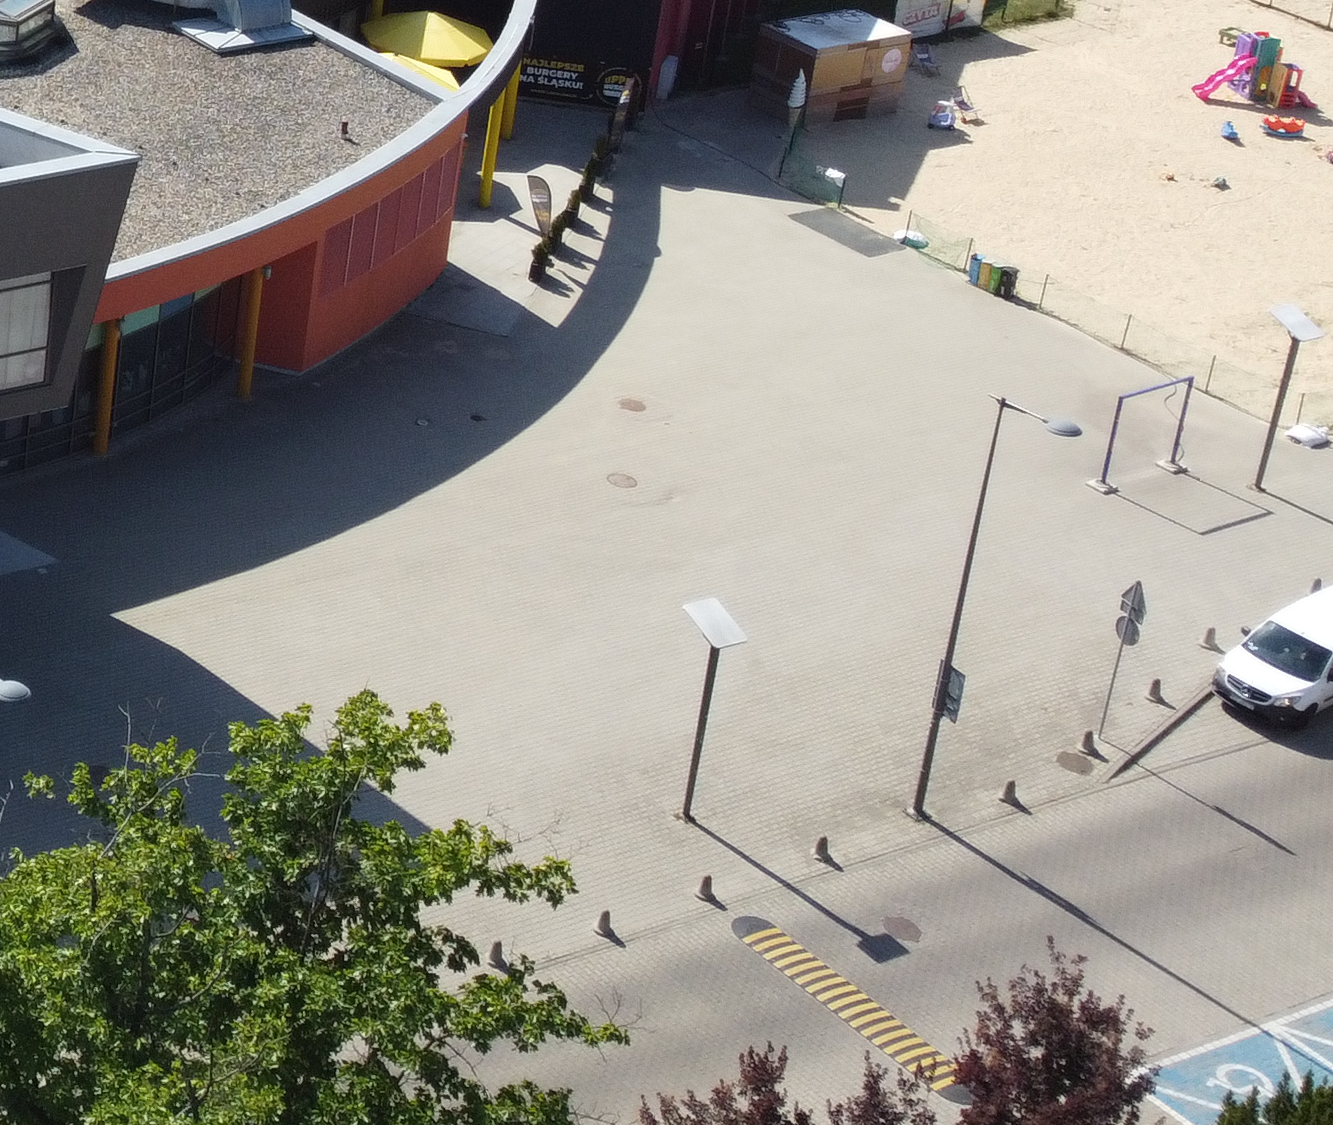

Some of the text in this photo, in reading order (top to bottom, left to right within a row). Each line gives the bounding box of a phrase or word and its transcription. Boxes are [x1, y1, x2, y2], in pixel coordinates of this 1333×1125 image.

[523, 57, 585, 72] NAJLEPSZE
[519, 74, 535, 83] NA
[527, 66, 579, 80] BURGERY
